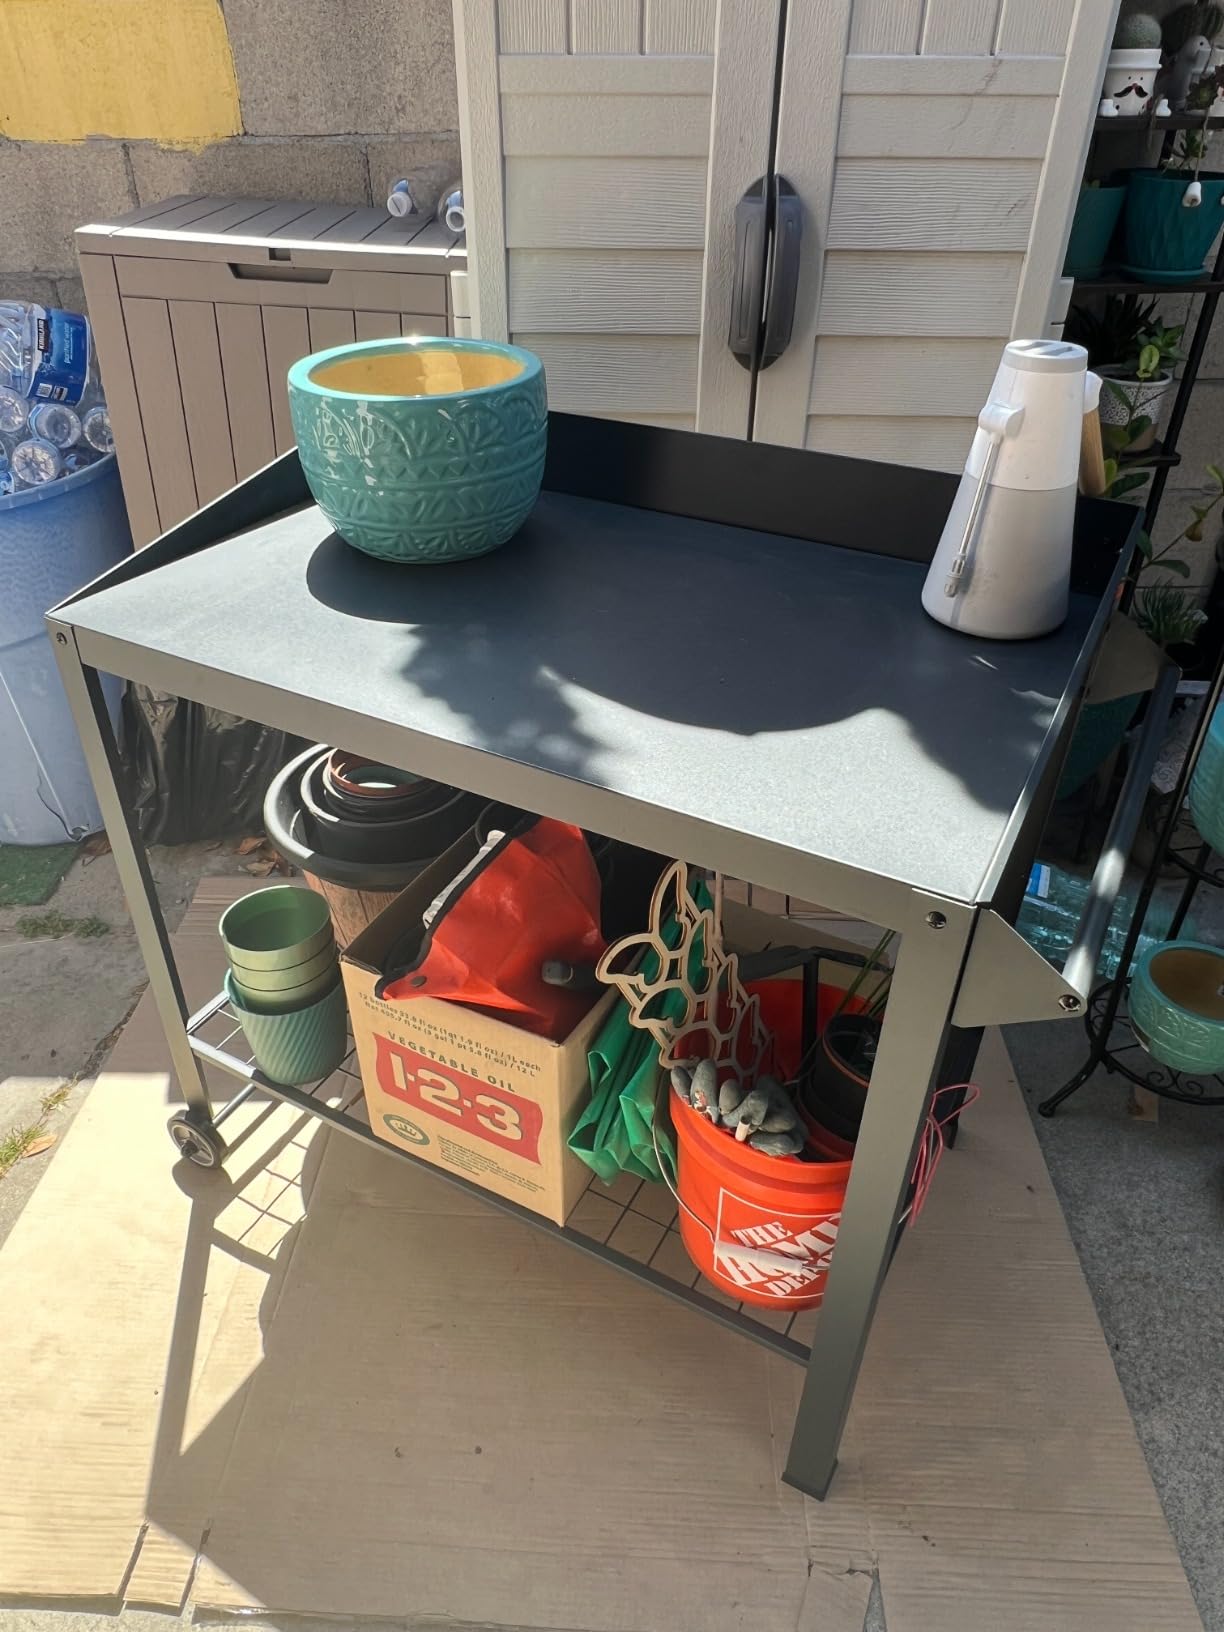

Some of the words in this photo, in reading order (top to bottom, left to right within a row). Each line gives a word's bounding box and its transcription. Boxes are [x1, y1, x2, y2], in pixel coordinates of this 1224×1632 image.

[388, 1030, 479, 1078] VEGETABLE
[487, 1075, 515, 1093] OIL
[730, 1221, 793, 1247] THE
